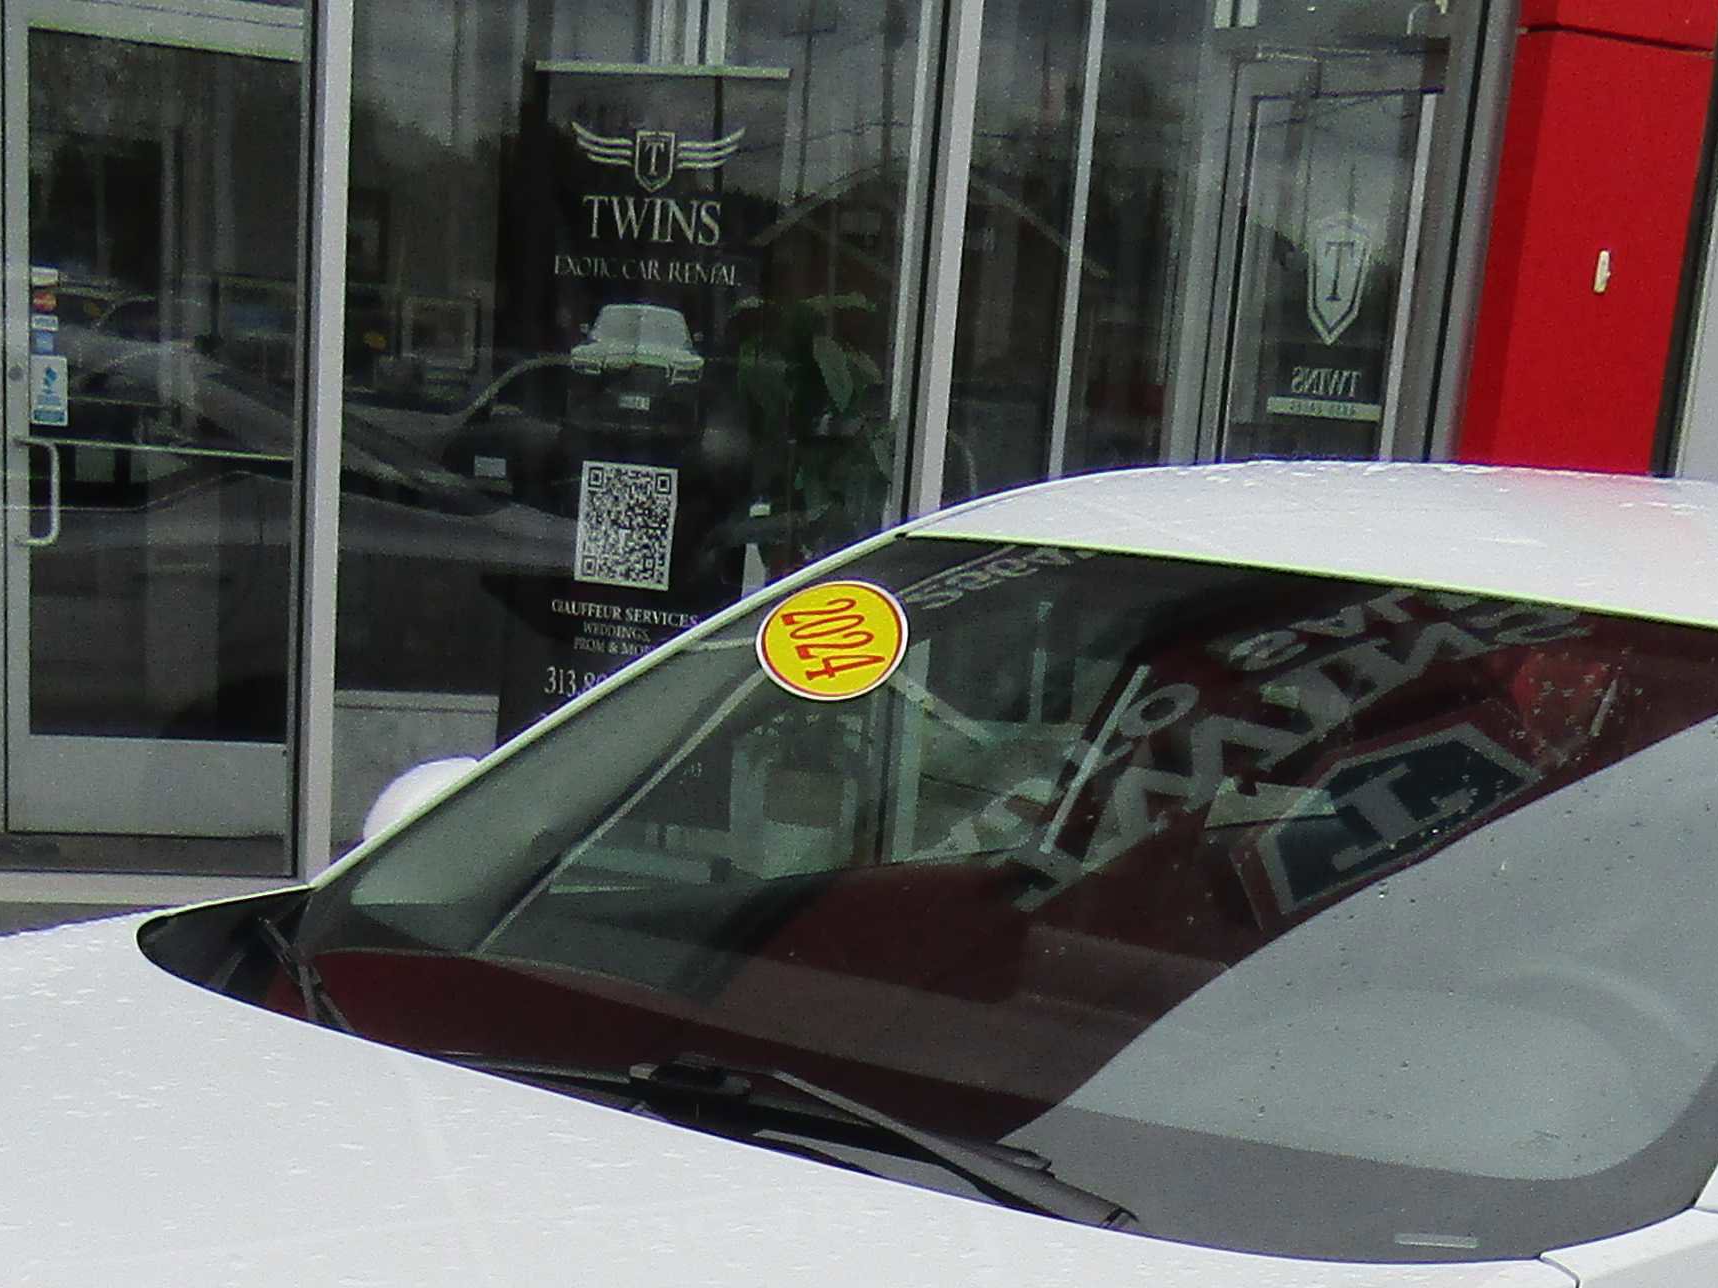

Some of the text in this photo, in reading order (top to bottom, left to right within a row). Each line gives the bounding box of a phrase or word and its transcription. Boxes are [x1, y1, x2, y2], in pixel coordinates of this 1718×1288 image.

[645, 141, 665, 176] T
[583, 195, 721, 246] TWINS
[554, 254, 741, 287] EXOTIC CAR RENTAL
[551, 599, 623, 620] CHAUFFEUR
[781, 597, 885, 681] 2024
